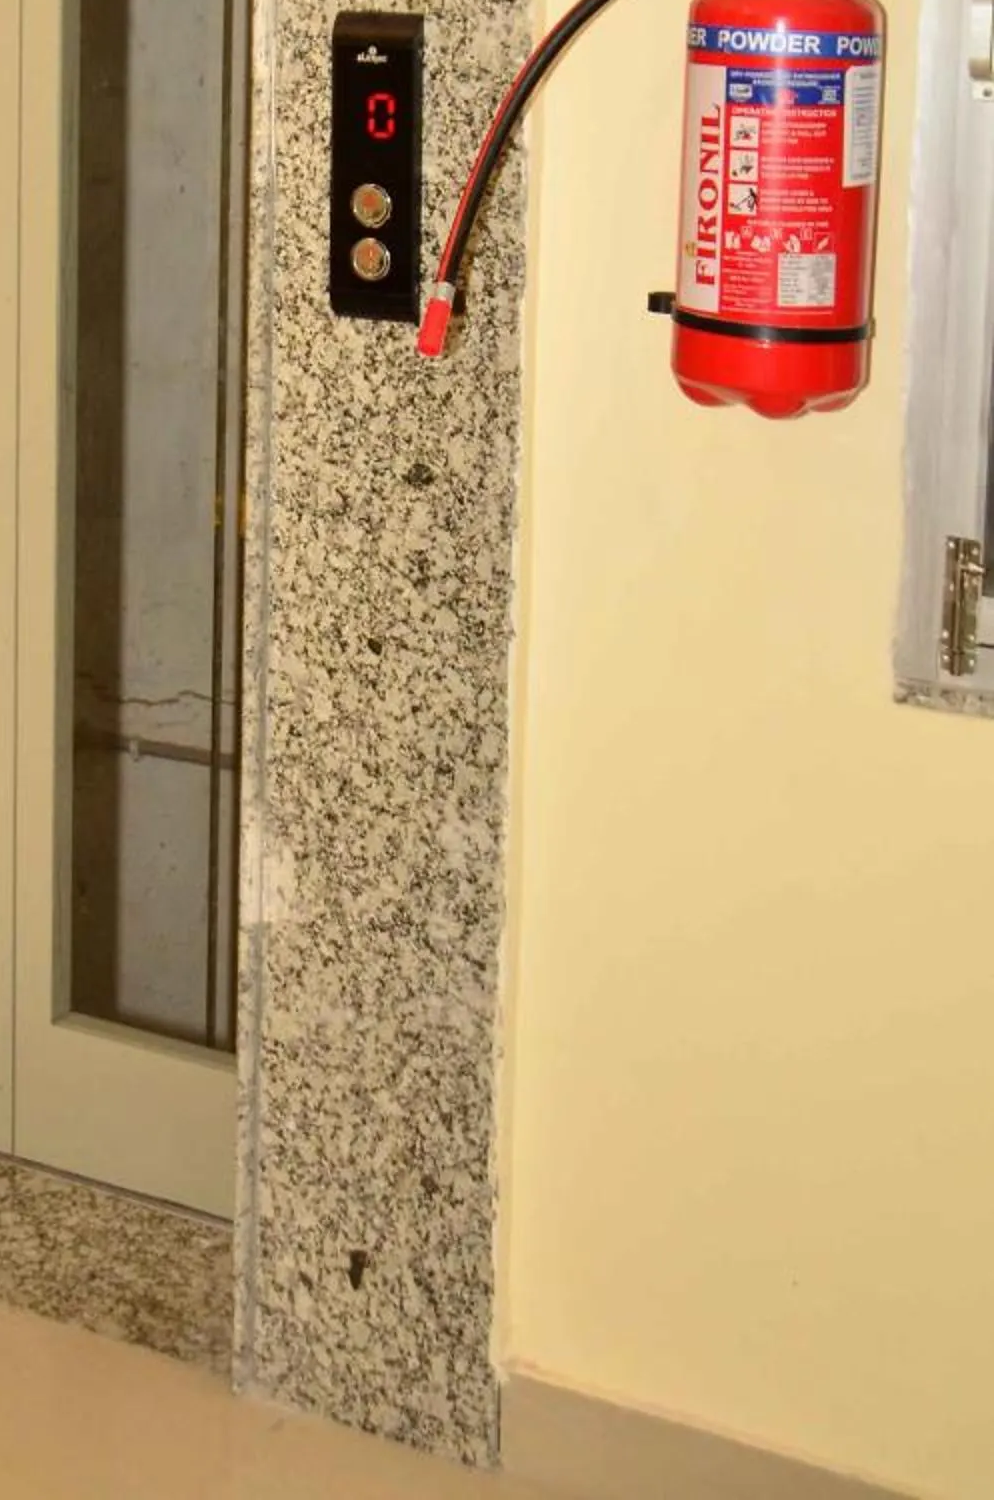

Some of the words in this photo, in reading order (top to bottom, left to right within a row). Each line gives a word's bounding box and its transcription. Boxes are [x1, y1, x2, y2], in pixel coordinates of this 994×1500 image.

[718, 29, 821, 55] POWDER
[368, 93, 395, 139] 0
[695, 103, 721, 286] FIRONIL
